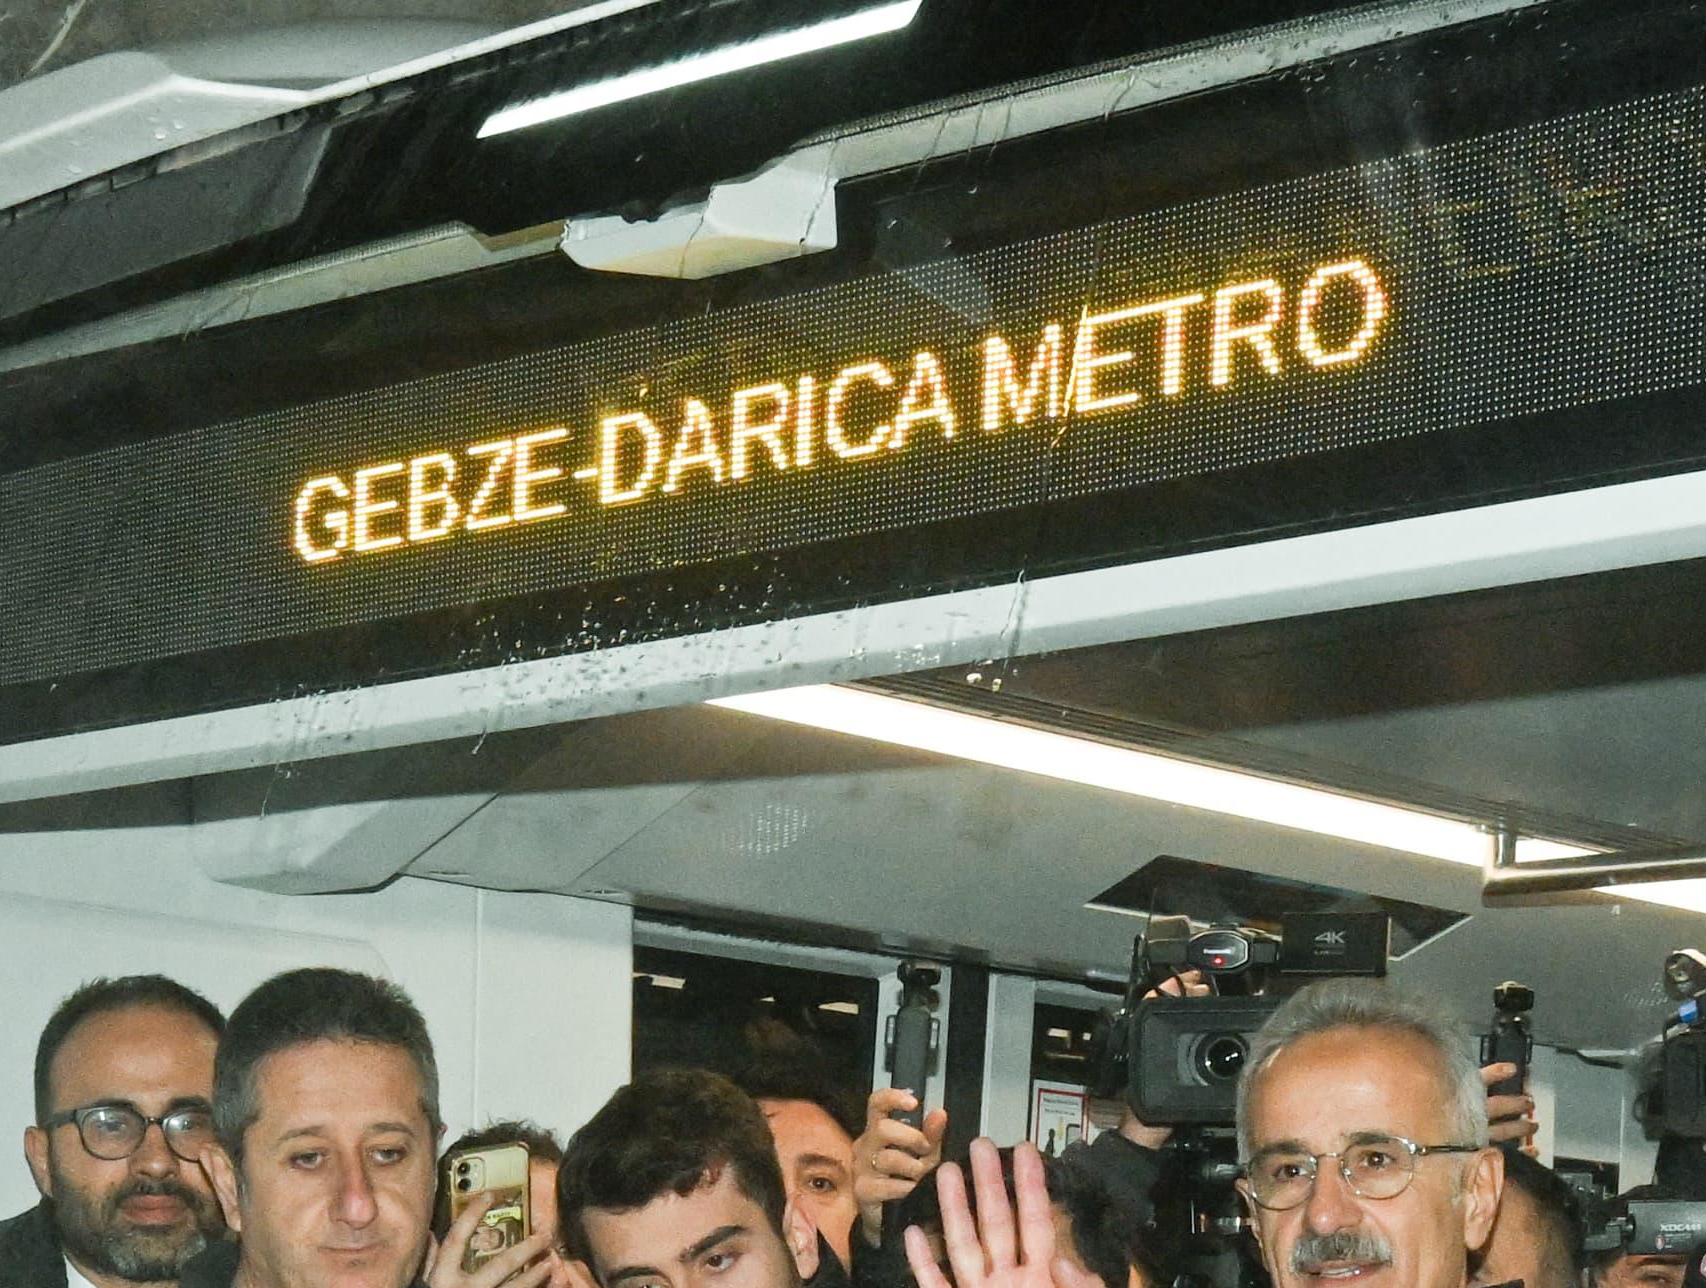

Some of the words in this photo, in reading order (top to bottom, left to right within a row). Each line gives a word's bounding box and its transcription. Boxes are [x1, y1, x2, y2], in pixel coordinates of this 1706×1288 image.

[292, 349, 960, 566] GEBZE-DARICA
[978, 254, 1391, 431] METRO
[1314, 930, 1347, 944] 4K
